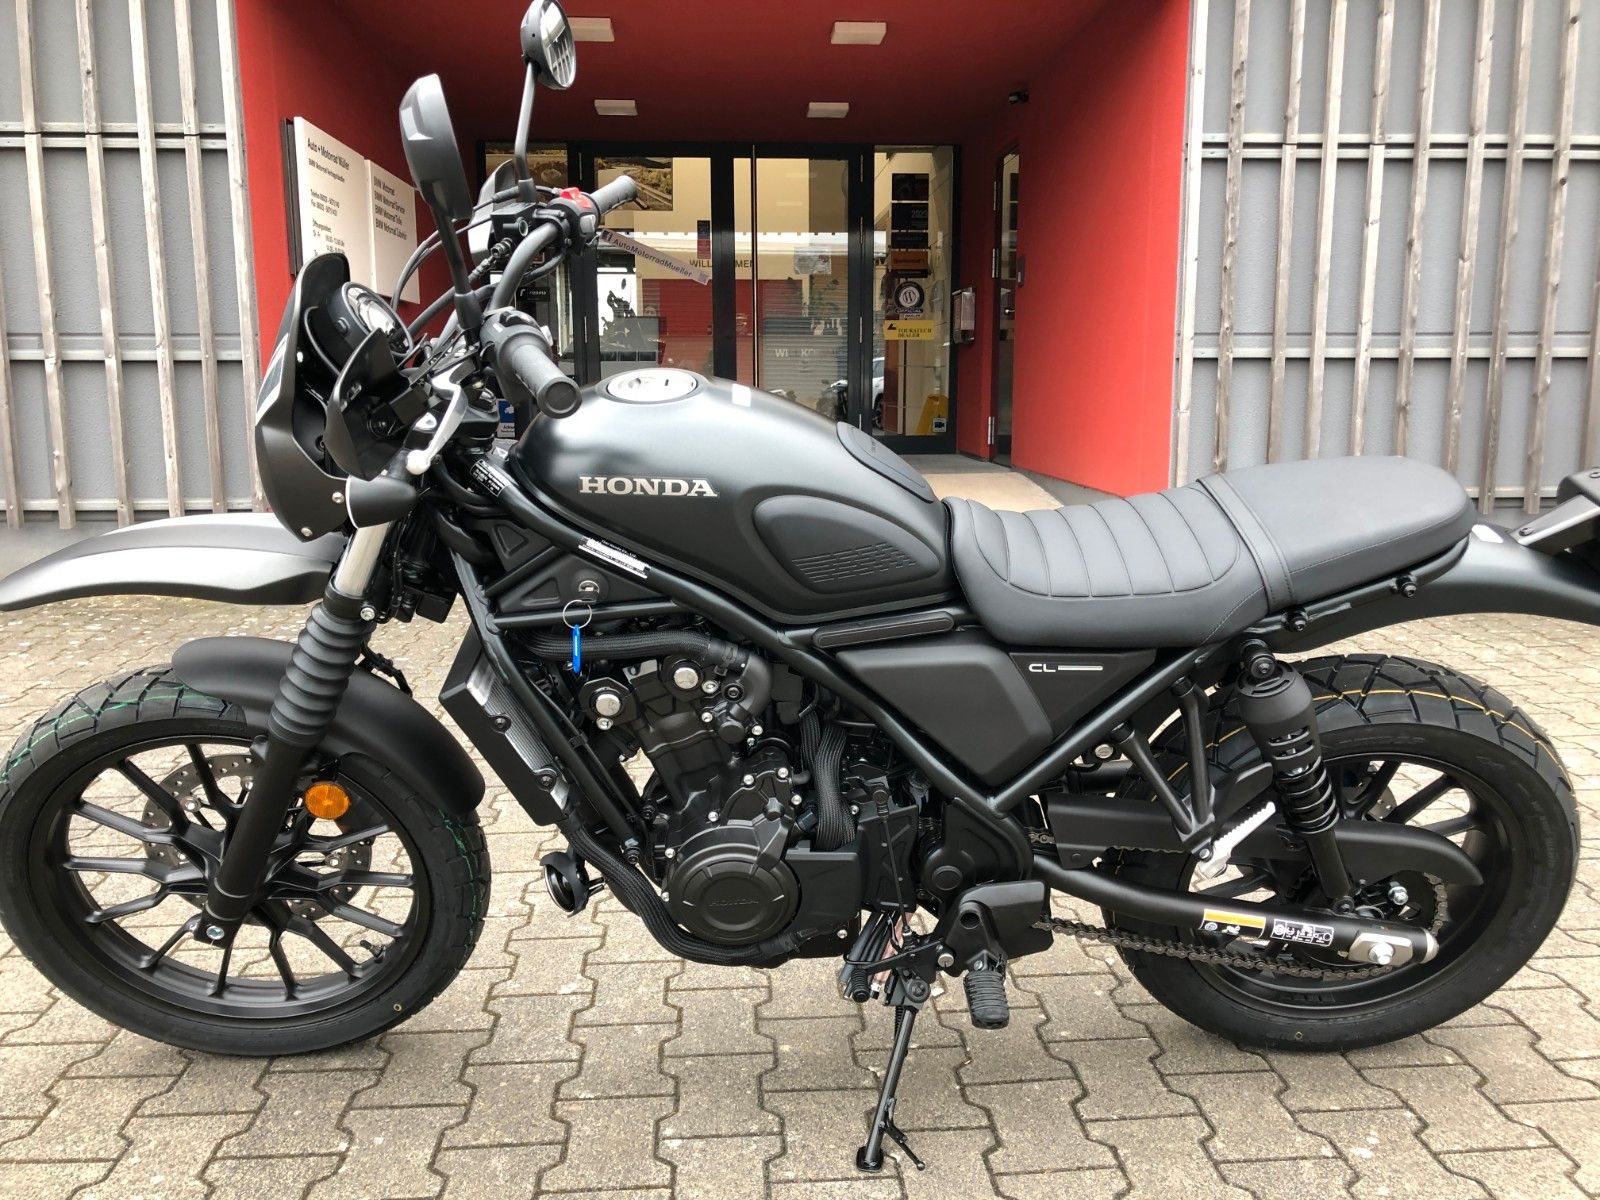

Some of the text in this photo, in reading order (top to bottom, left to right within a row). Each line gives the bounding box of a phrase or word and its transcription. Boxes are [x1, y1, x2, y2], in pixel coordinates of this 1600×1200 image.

[613, 238, 692, 277] AutoMotorradMueller
[579, 476, 718, 498] HONDA
[1028, 663, 1056, 673] CL
